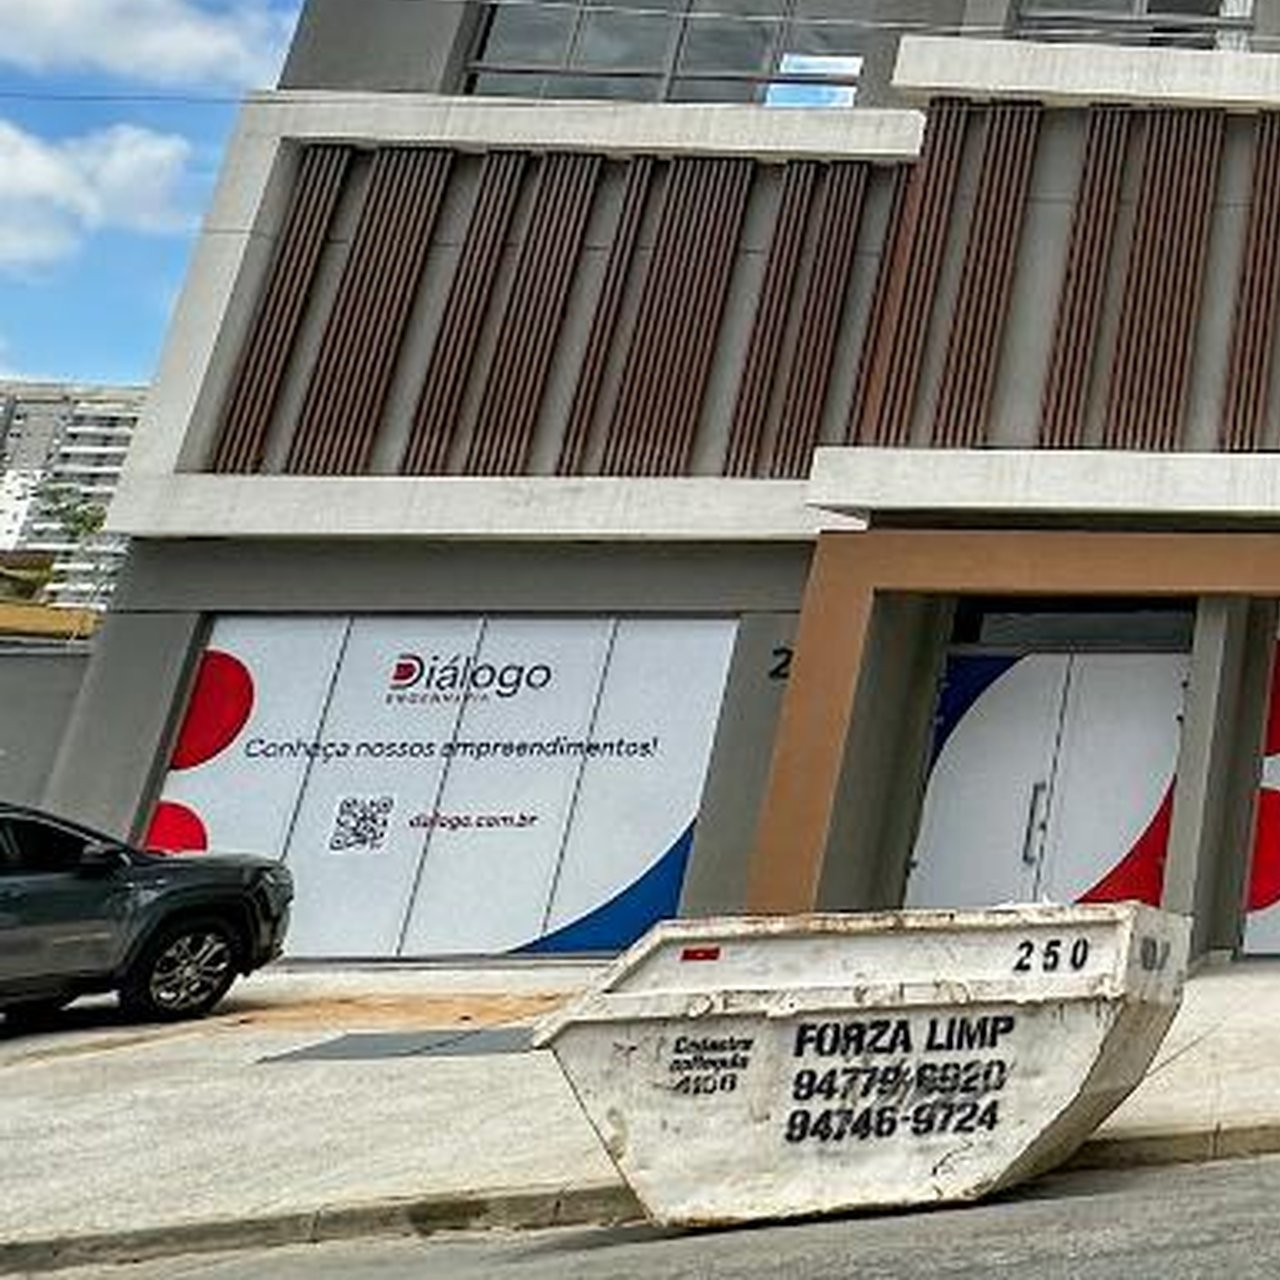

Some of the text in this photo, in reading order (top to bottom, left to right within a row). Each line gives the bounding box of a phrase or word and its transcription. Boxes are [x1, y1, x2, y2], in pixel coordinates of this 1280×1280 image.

[389, 654, 551, 697] Diálogo
[245, 736, 659, 763] Conheça nossos empreendimentos!
[408, 812, 538, 831] dialogo.com.br
[1014, 938, 1089, 972] 250
[794, 1016, 1014, 1057] FORZA LIMP
[785, 1100, 999, 1143] 94746-9724
